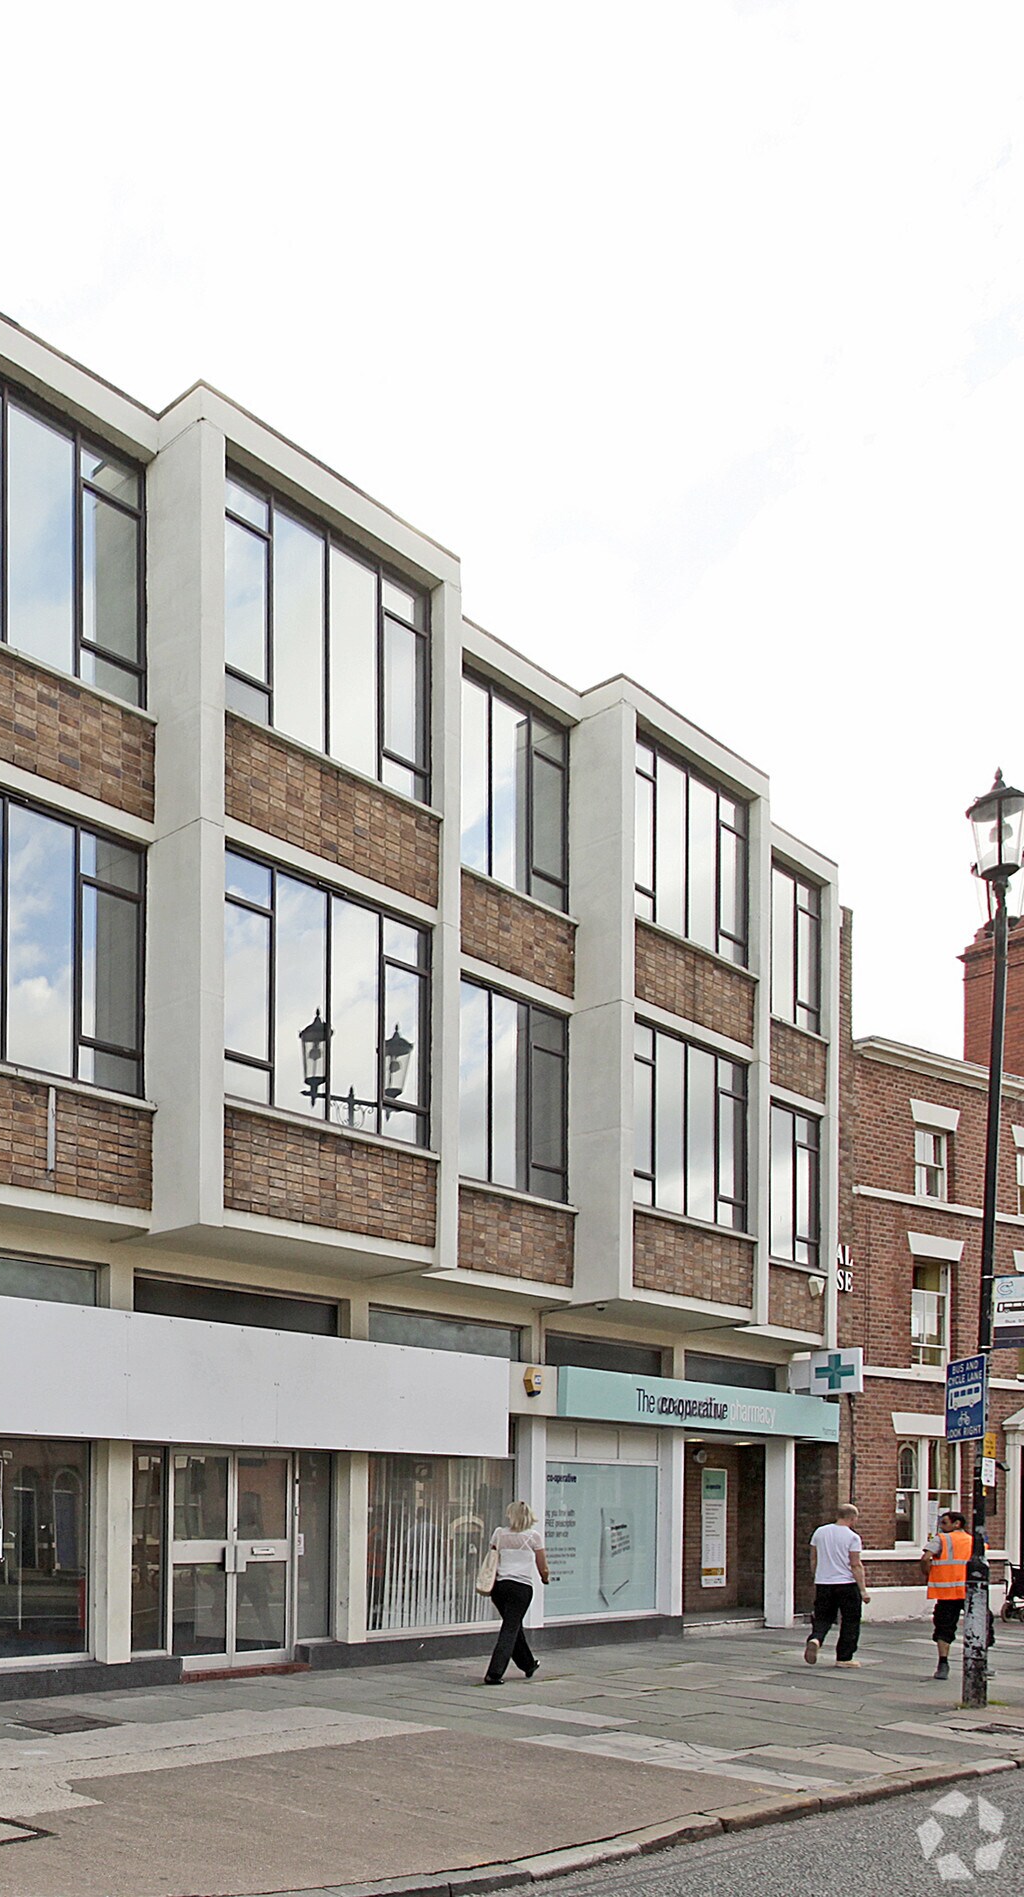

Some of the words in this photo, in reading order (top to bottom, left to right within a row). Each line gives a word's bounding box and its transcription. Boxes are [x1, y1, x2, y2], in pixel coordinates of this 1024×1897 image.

[951, 1363, 965, 1375] BUS
[965, 1360, 979, 1372] AND
[948, 1373, 966, 1387] CYCLE
[967, 1369, 983, 1382] LANE
[636, 1388, 656, 1414] The
[729, 1400, 776, 1429] pharmacy
[947, 1427, 962, 1439] LOOK
[963, 1424, 982, 1436] RIGHT
